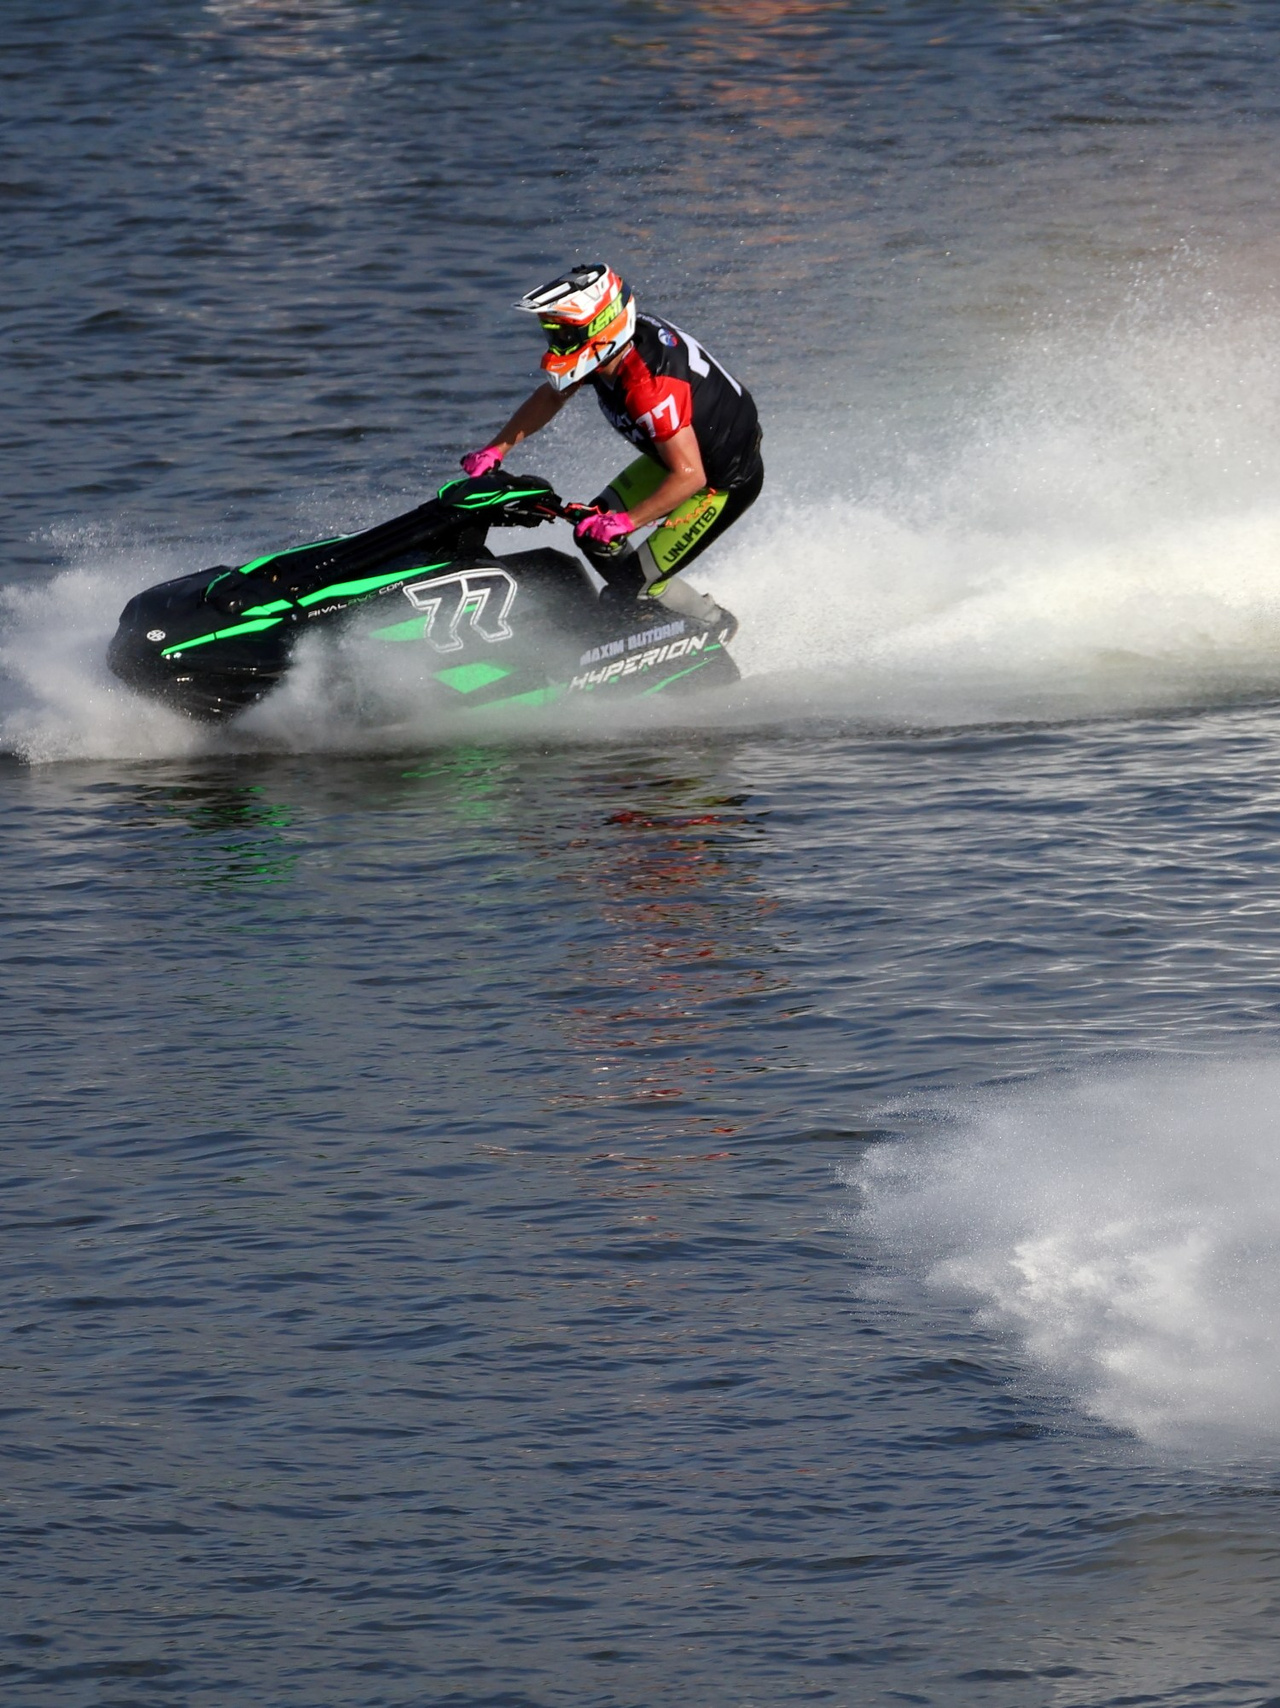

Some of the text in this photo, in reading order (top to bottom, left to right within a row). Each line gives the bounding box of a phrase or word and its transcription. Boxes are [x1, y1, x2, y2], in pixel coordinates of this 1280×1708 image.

[635, 393, 680, 438] 77
[663, 506, 717, 563] UNLIMITED
[403, 567, 517, 653] 77
[567, 631, 709, 695] HYPERION
[580, 639, 625, 666] MAXIM
